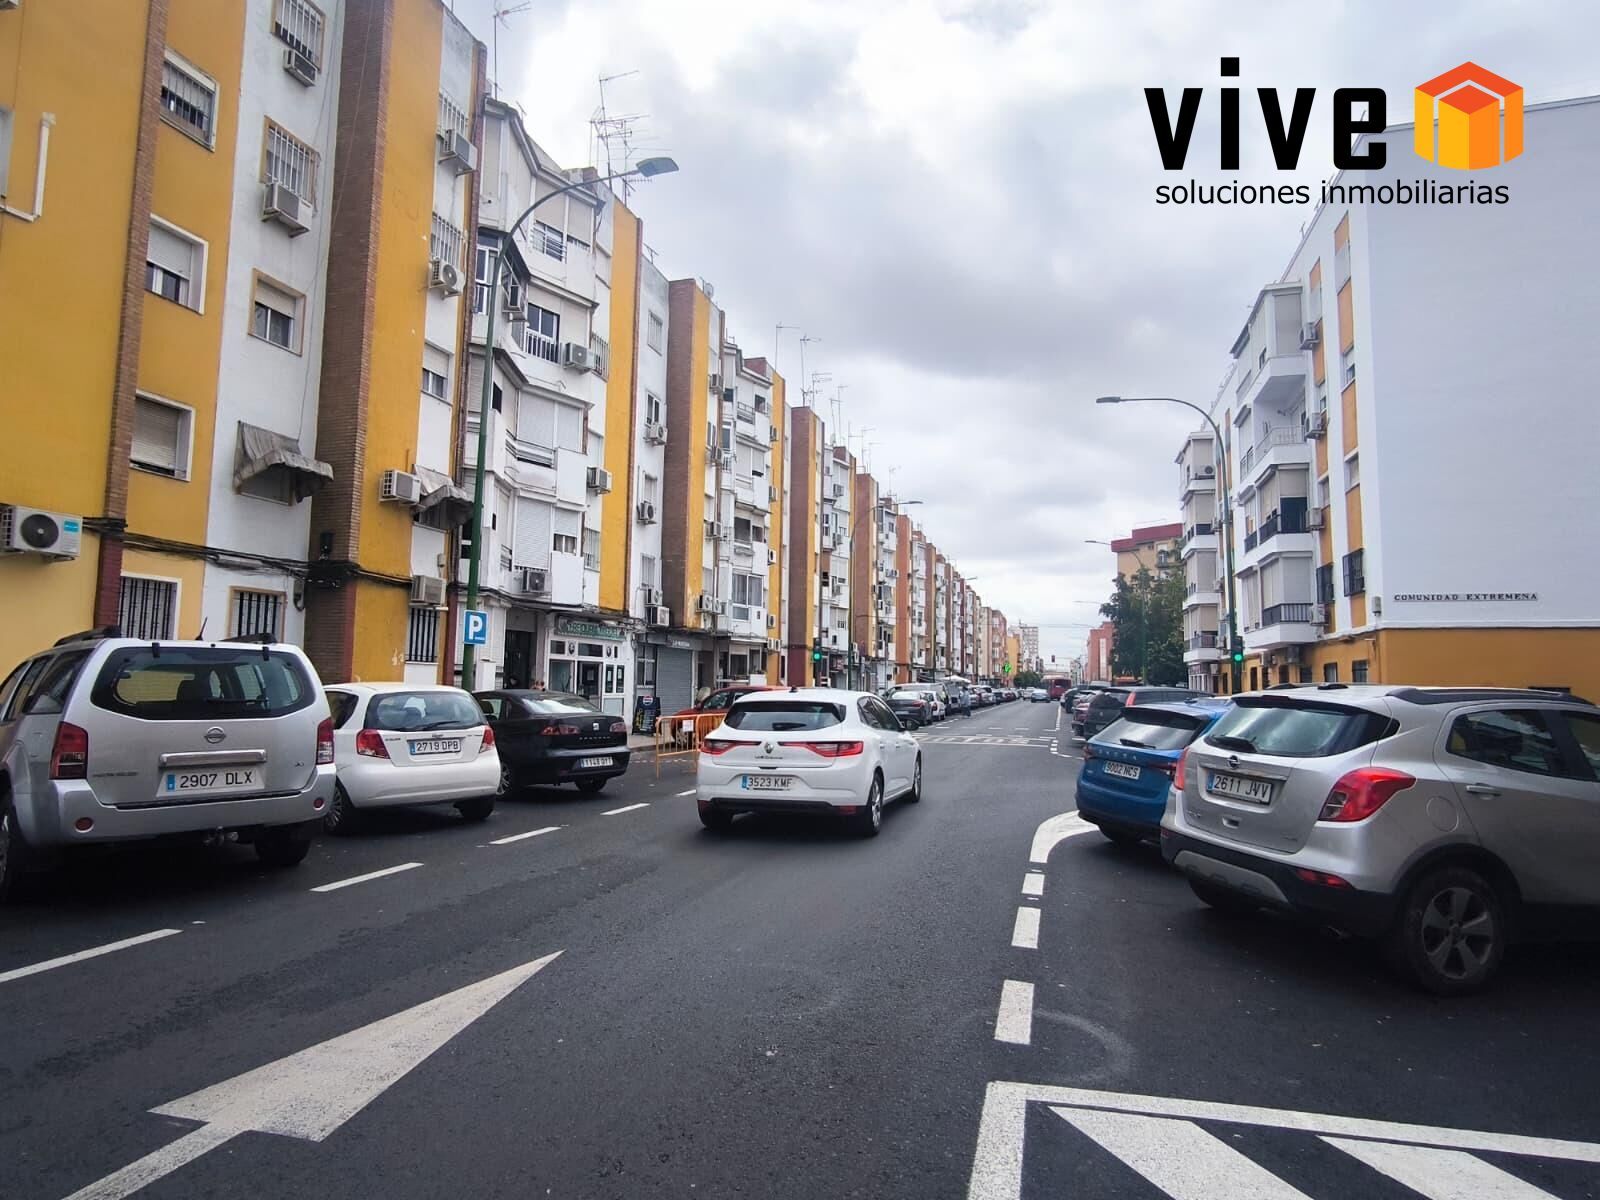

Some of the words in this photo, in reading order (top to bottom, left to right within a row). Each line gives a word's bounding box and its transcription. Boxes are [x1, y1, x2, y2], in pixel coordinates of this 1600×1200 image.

[469, 615, 482, 640] P
[416, 741, 440, 752] 2719
[441, 740, 459, 750] DPB
[179, 774, 218, 789] 2907
[225, 771, 253, 786] DLX
[748, 777, 772, 788] 3523
[1214, 775, 1241, 796] 2611
[1245, 780, 1269, 799] JVV
